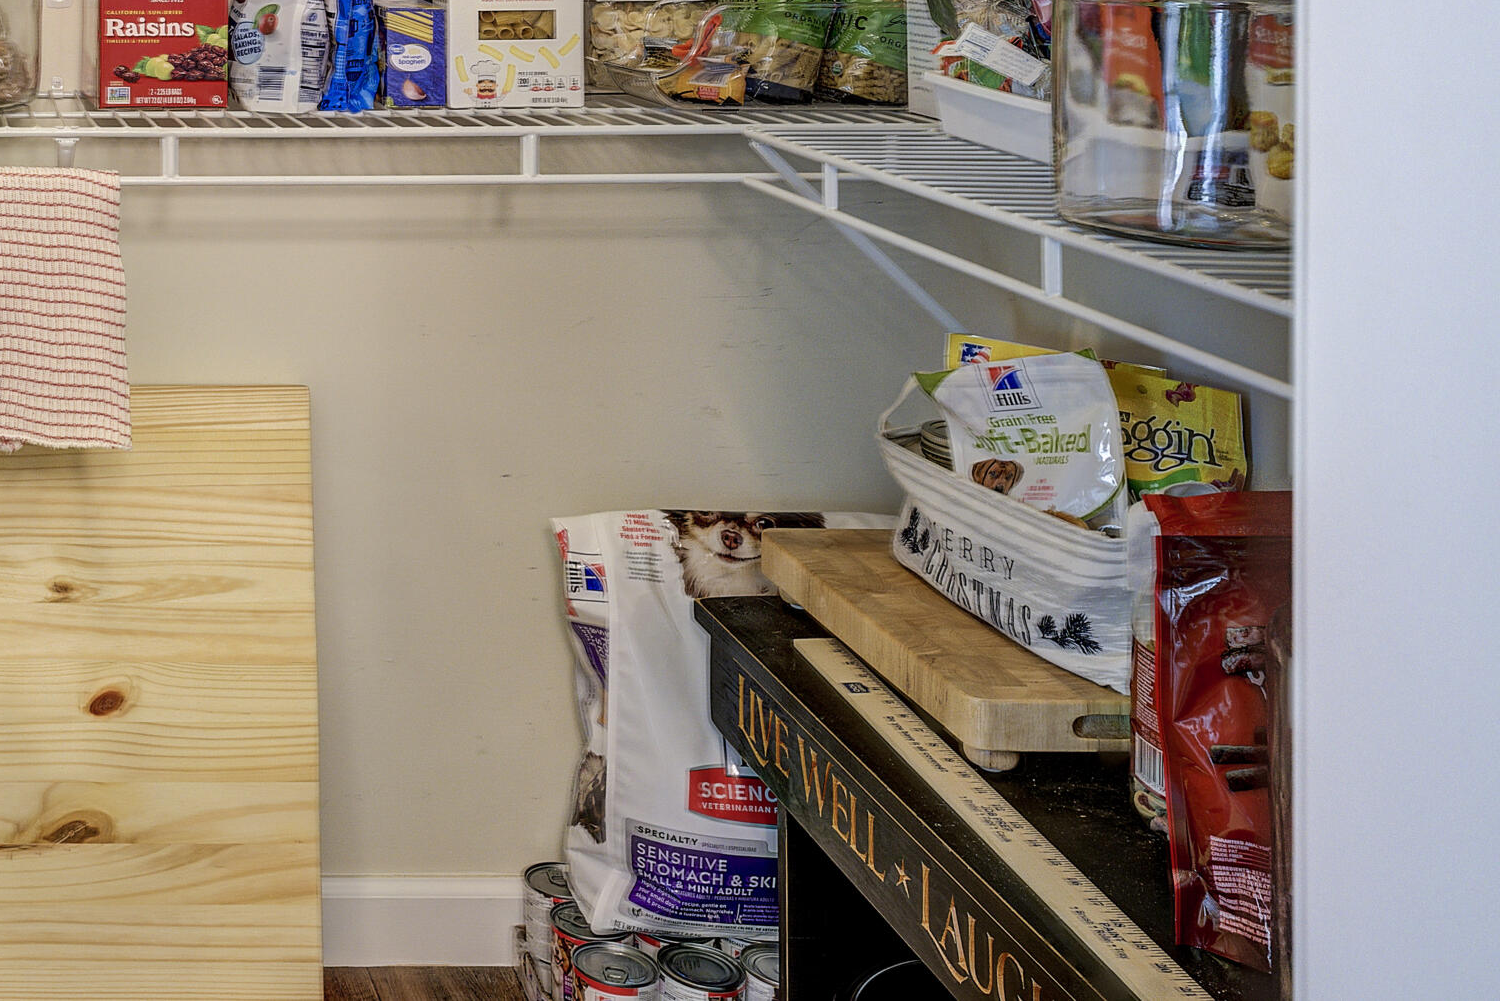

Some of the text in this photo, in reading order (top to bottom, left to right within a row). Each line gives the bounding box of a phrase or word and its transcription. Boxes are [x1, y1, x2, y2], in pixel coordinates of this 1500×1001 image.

[104, 17, 195, 37] Raisins
[233, 31, 260, 40] SALADS,
[234, 40, 256, 49] BAKING
[236, 47, 262, 57] RECIPES
[397, 58, 427, 67] Spaghetti
[995, 391, 1032, 407] Hill's
[987, 413, 1057, 427] Grain Free
[567, 560, 581, 594] Hill's
[737, 673, 792, 778] LIVE
[701, 802, 772, 814] VETERINARIAN
[796, 733, 886, 884] WELL
[637, 825, 699, 846] SPECIALTY
[636, 843, 729, 873] SENSITIVE
[636, 856, 743, 887] STOMACH &
[637, 869, 754, 897] SMALL MINI ADULT
[635, 892, 679, 916] skin promotes
[650, 891, 665, 903] small
[665, 898, 679, 911] dog's
[1099, 921, 1129, 944] PAINT
[1132, 939, 1149, 951] 19
[1153, 962, 1173, 974] 20
